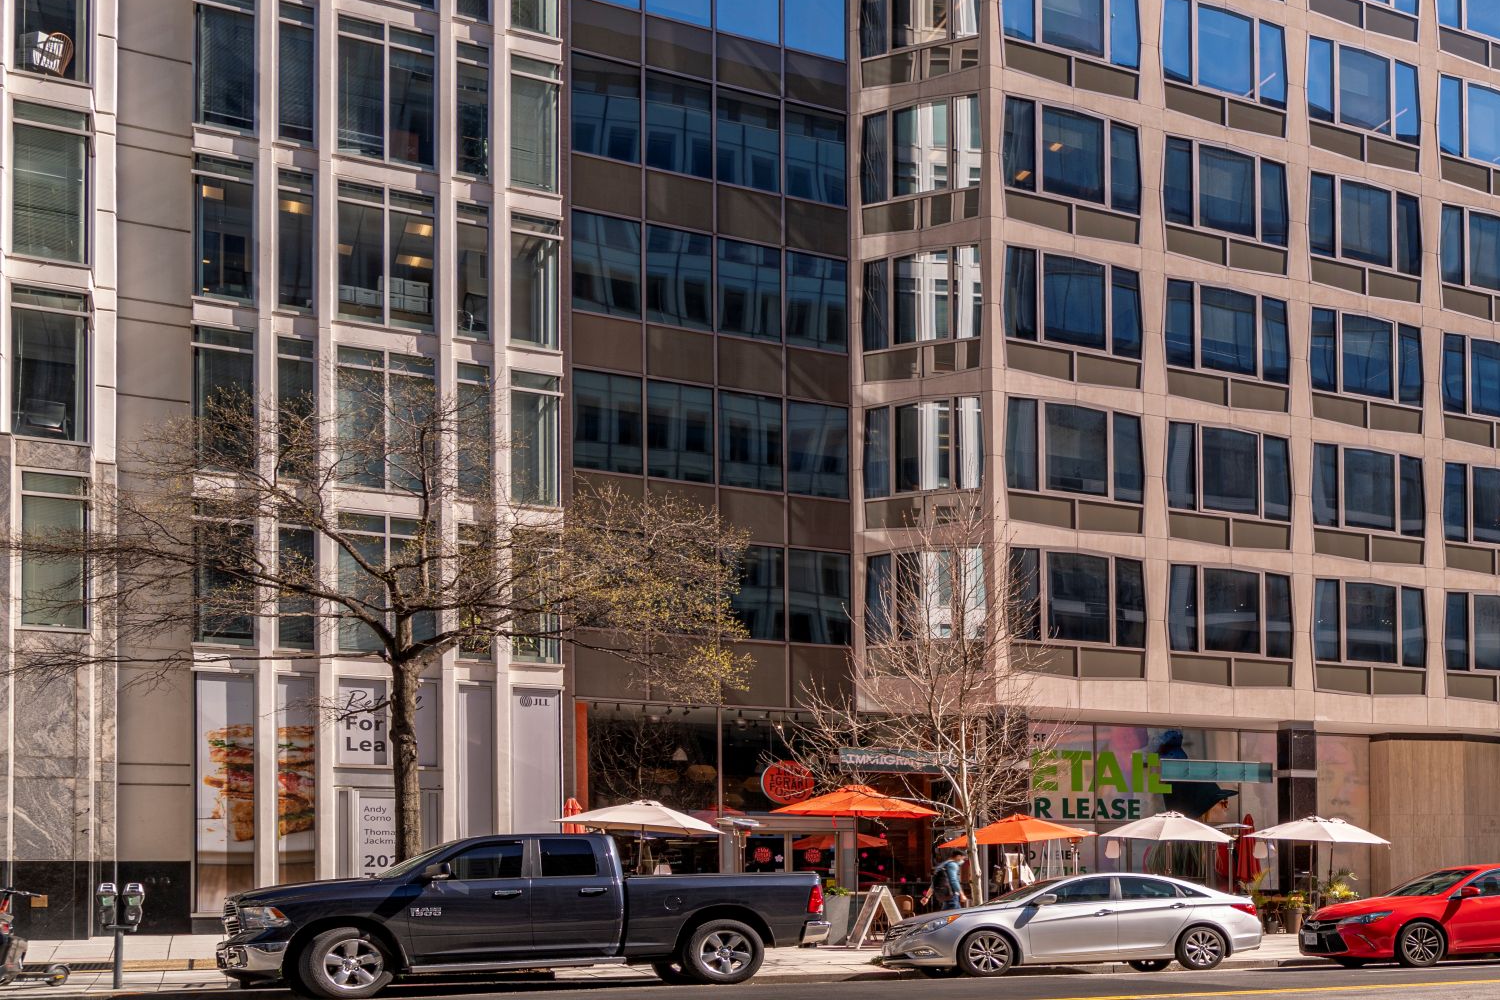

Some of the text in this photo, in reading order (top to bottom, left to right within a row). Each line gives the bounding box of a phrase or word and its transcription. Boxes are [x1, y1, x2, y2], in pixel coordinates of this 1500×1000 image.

[345, 690, 424, 711] Retl
[533, 698, 550, 706] JLL
[345, 716, 384, 731] For
[346, 736, 386, 752] Lea
[1032, 750, 1173, 794] ETAIL
[364, 806, 387, 814] Andy
[1028, 798, 1141, 819] R LEASE
[364, 828, 396, 836] Thoma
[364, 837, 397, 845] Jackm
